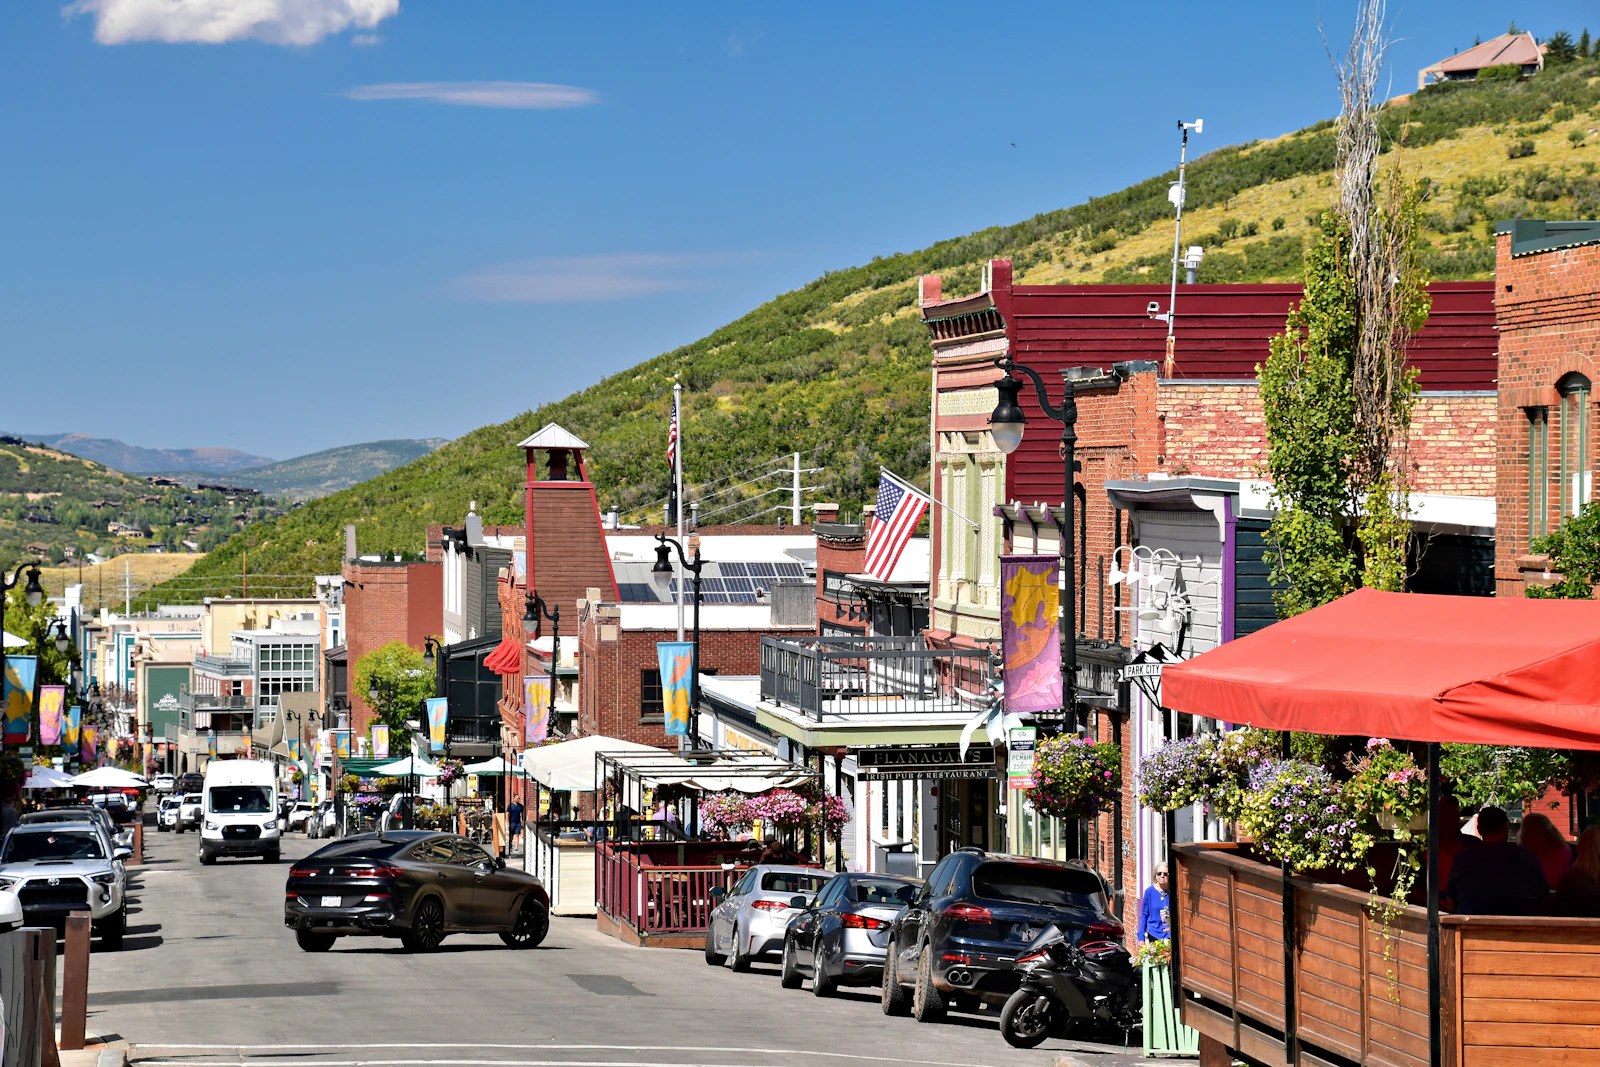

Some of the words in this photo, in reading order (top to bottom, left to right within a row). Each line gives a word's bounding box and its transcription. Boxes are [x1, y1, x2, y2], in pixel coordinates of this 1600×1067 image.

[1127, 665, 1144, 676] PARK
[1145, 664, 1160, 675] CITY
[926, 770, 989, 779] RESTAURANT
